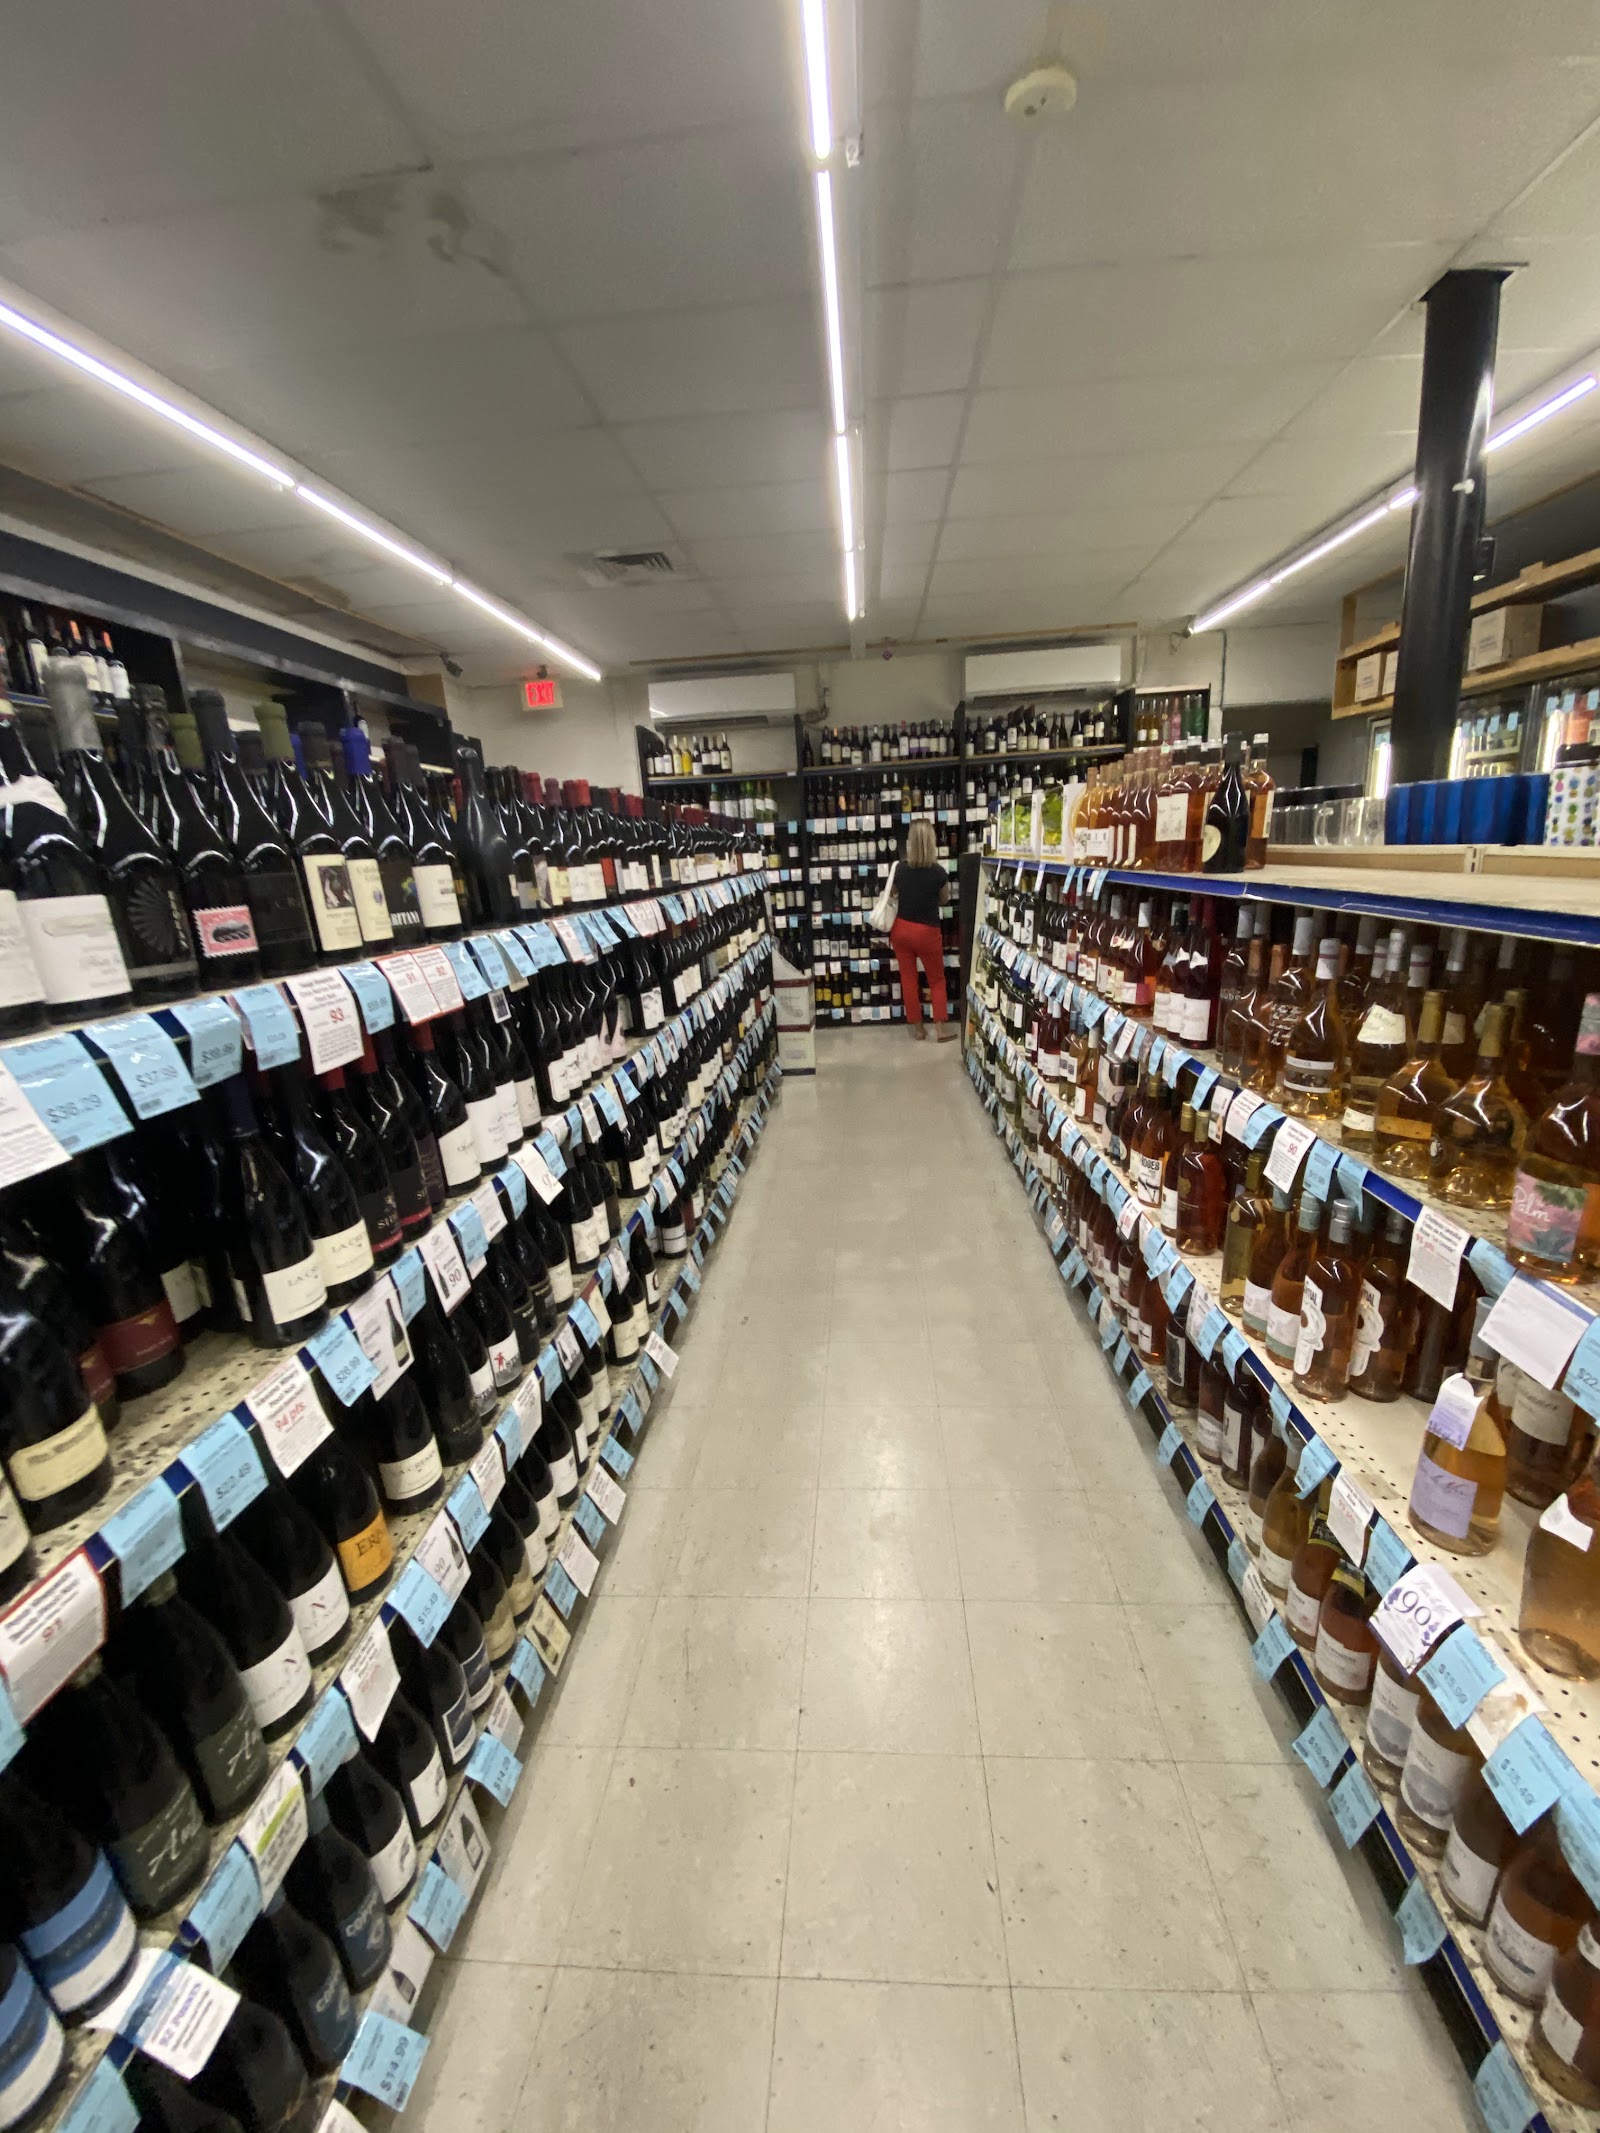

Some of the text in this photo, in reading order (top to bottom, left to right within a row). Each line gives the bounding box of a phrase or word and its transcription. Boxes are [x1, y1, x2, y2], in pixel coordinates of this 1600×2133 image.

[526, 681, 554, 707] EXIT
[1288, 1143, 1299, 1156] 90
[1513, 1185, 1551, 1222] Palm
[449, 1268, 462, 1287] 90
[274, 1414, 290, 1432] 94
[1393, 1590, 1433, 1627] 90
[380, 2034, 410, 2093] $14.99
